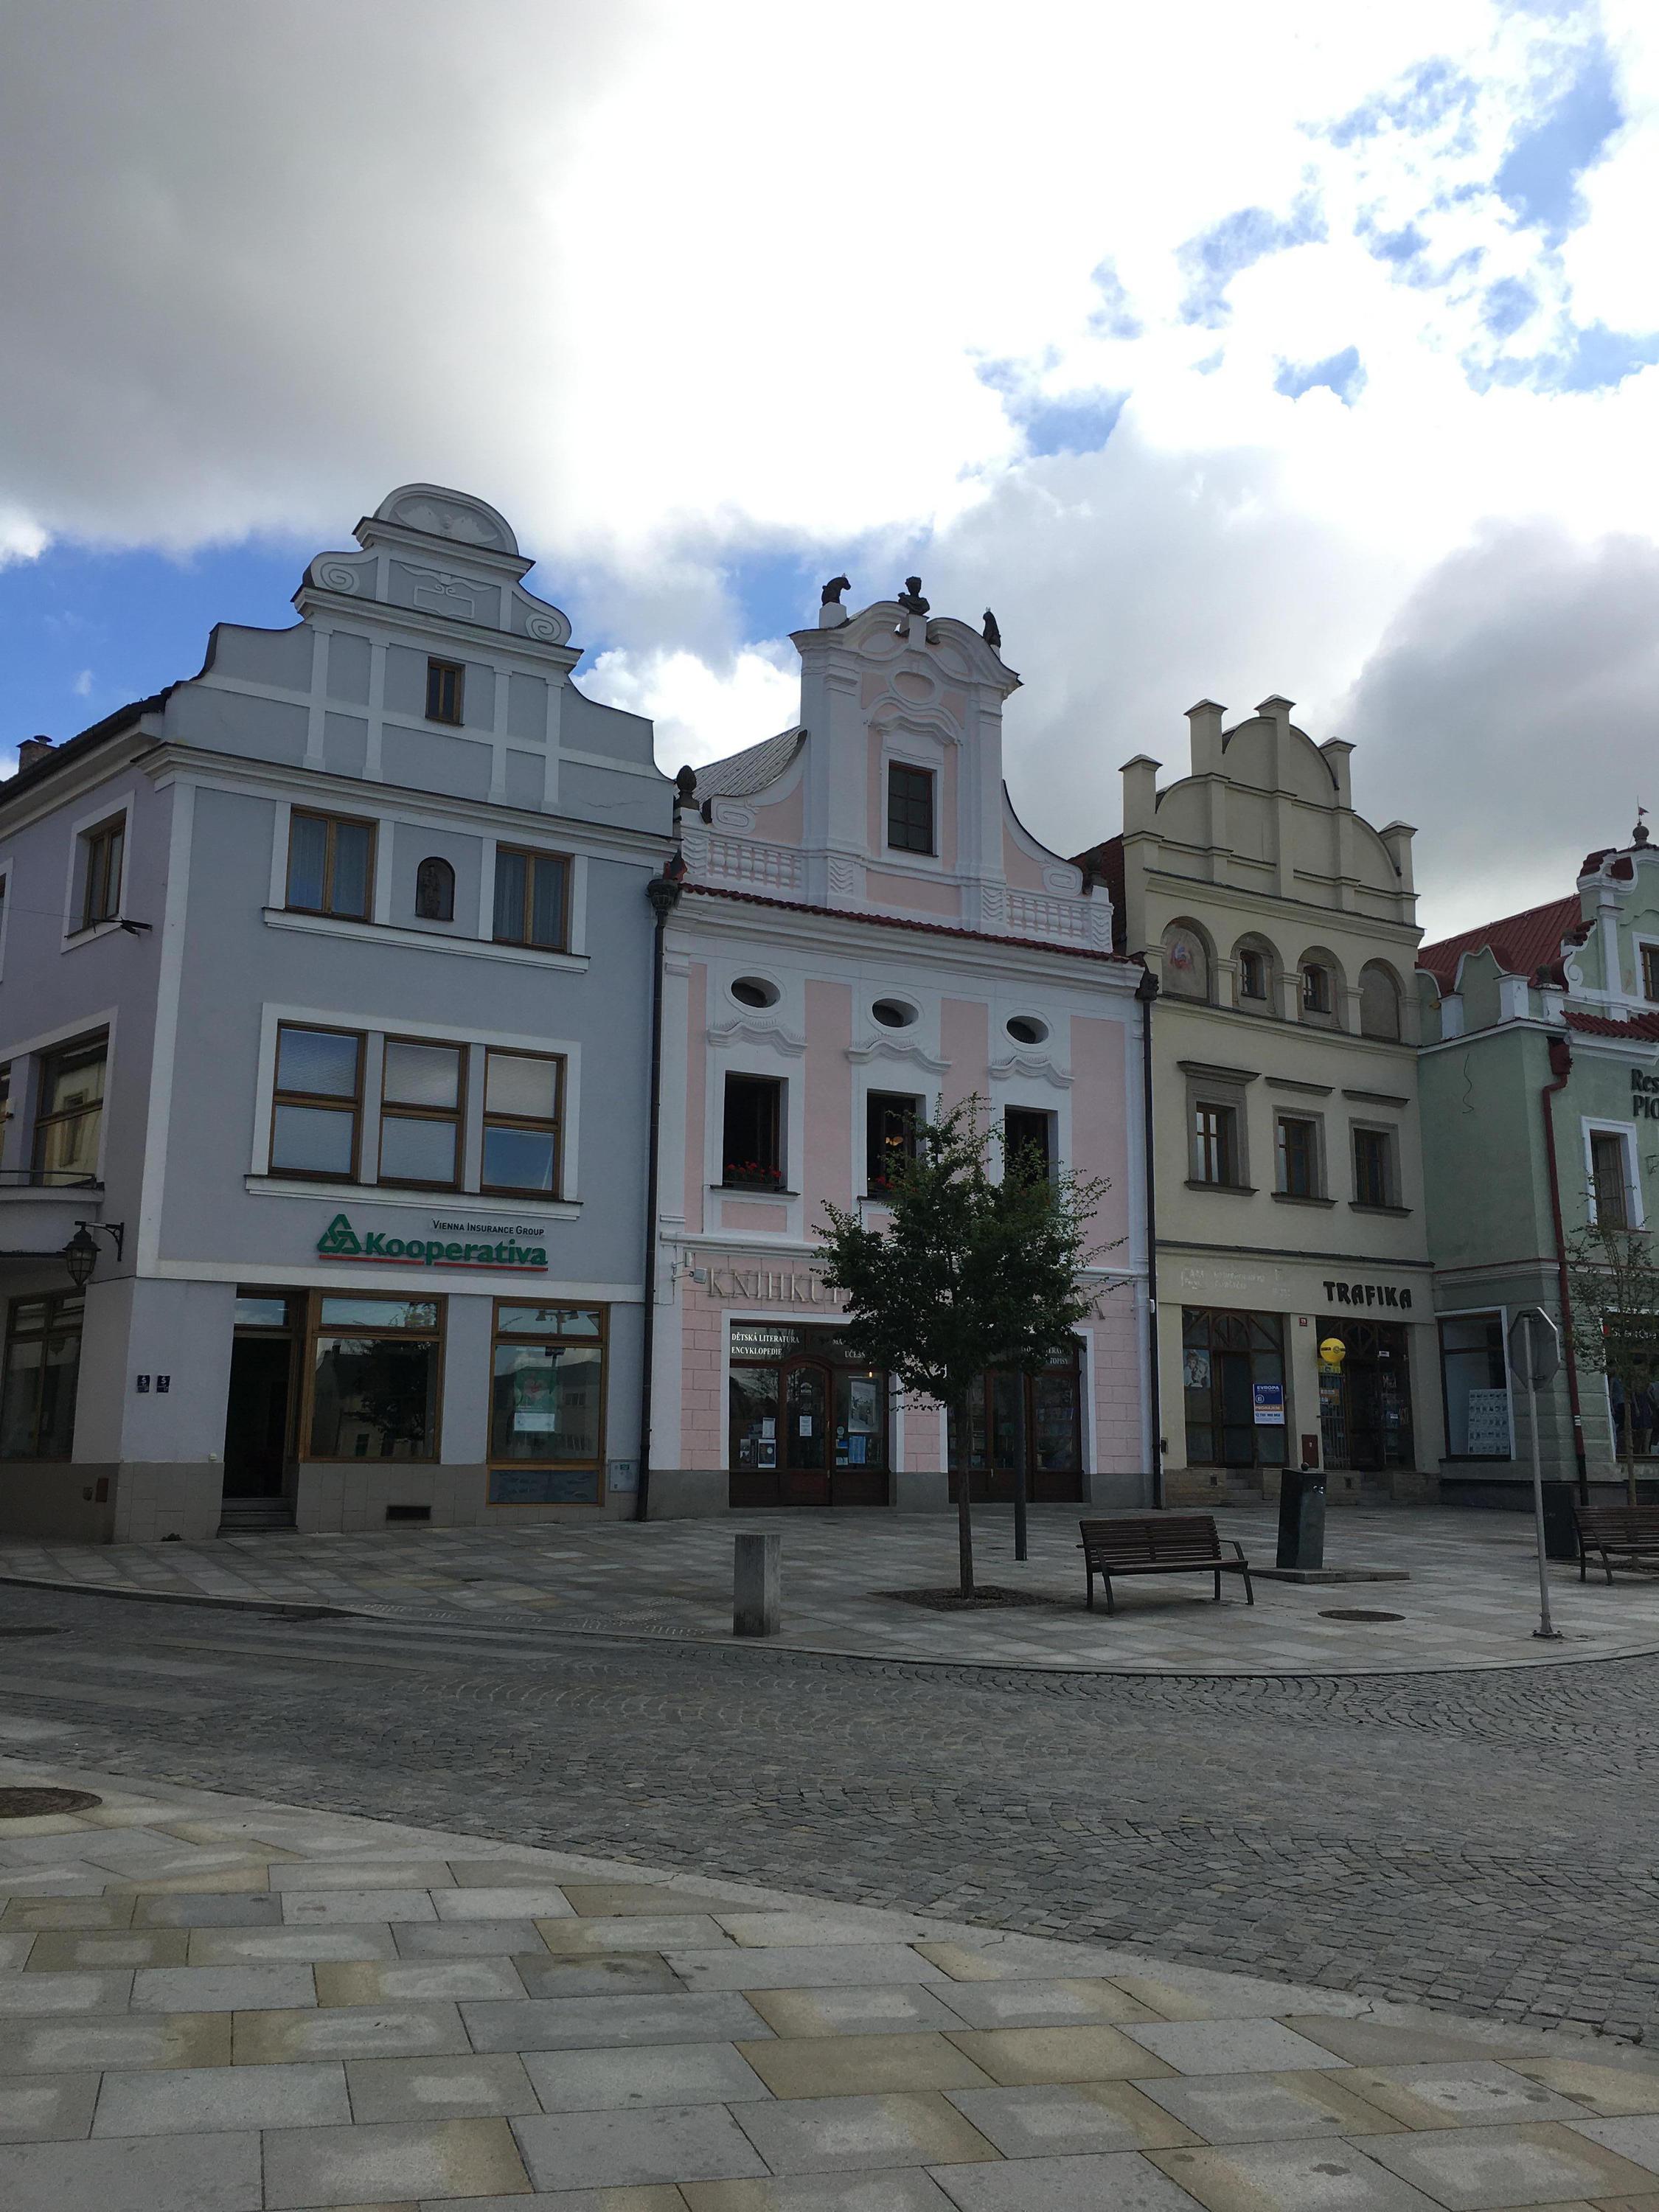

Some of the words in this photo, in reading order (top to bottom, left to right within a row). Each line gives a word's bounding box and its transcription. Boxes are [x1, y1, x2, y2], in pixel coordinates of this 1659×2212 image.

[365, 1231, 549, 1266] Kooperativa
[1323, 1281, 1412, 1310] TRAFIKA
[731, 1332, 758, 1342] DĚTSKÁ
[759, 1334, 800, 1343] LITERATURA
[731, 1346, 783, 1355] ENCYKLOPEDIE
